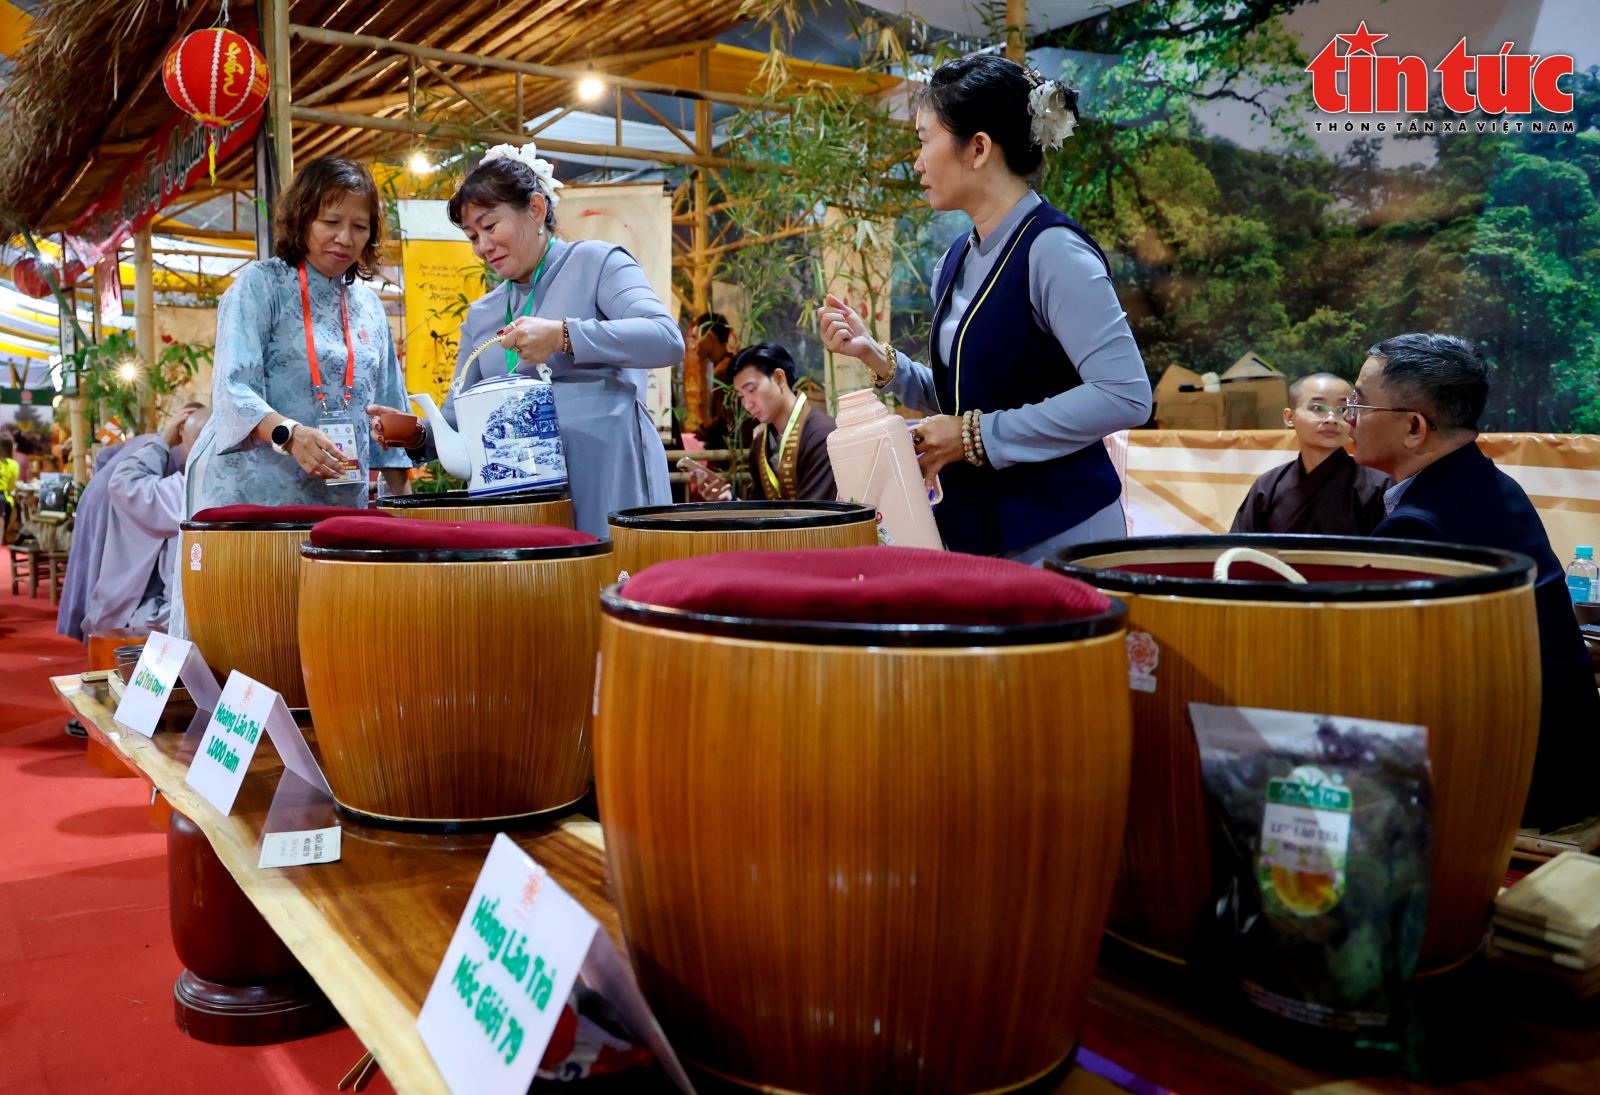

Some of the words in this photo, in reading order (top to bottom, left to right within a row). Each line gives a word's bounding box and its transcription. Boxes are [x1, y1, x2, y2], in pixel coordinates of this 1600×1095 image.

[245, 720, 260, 744] Trà
[526, 956, 556, 1011] Trà
[498, 1016, 524, 1065] 79
